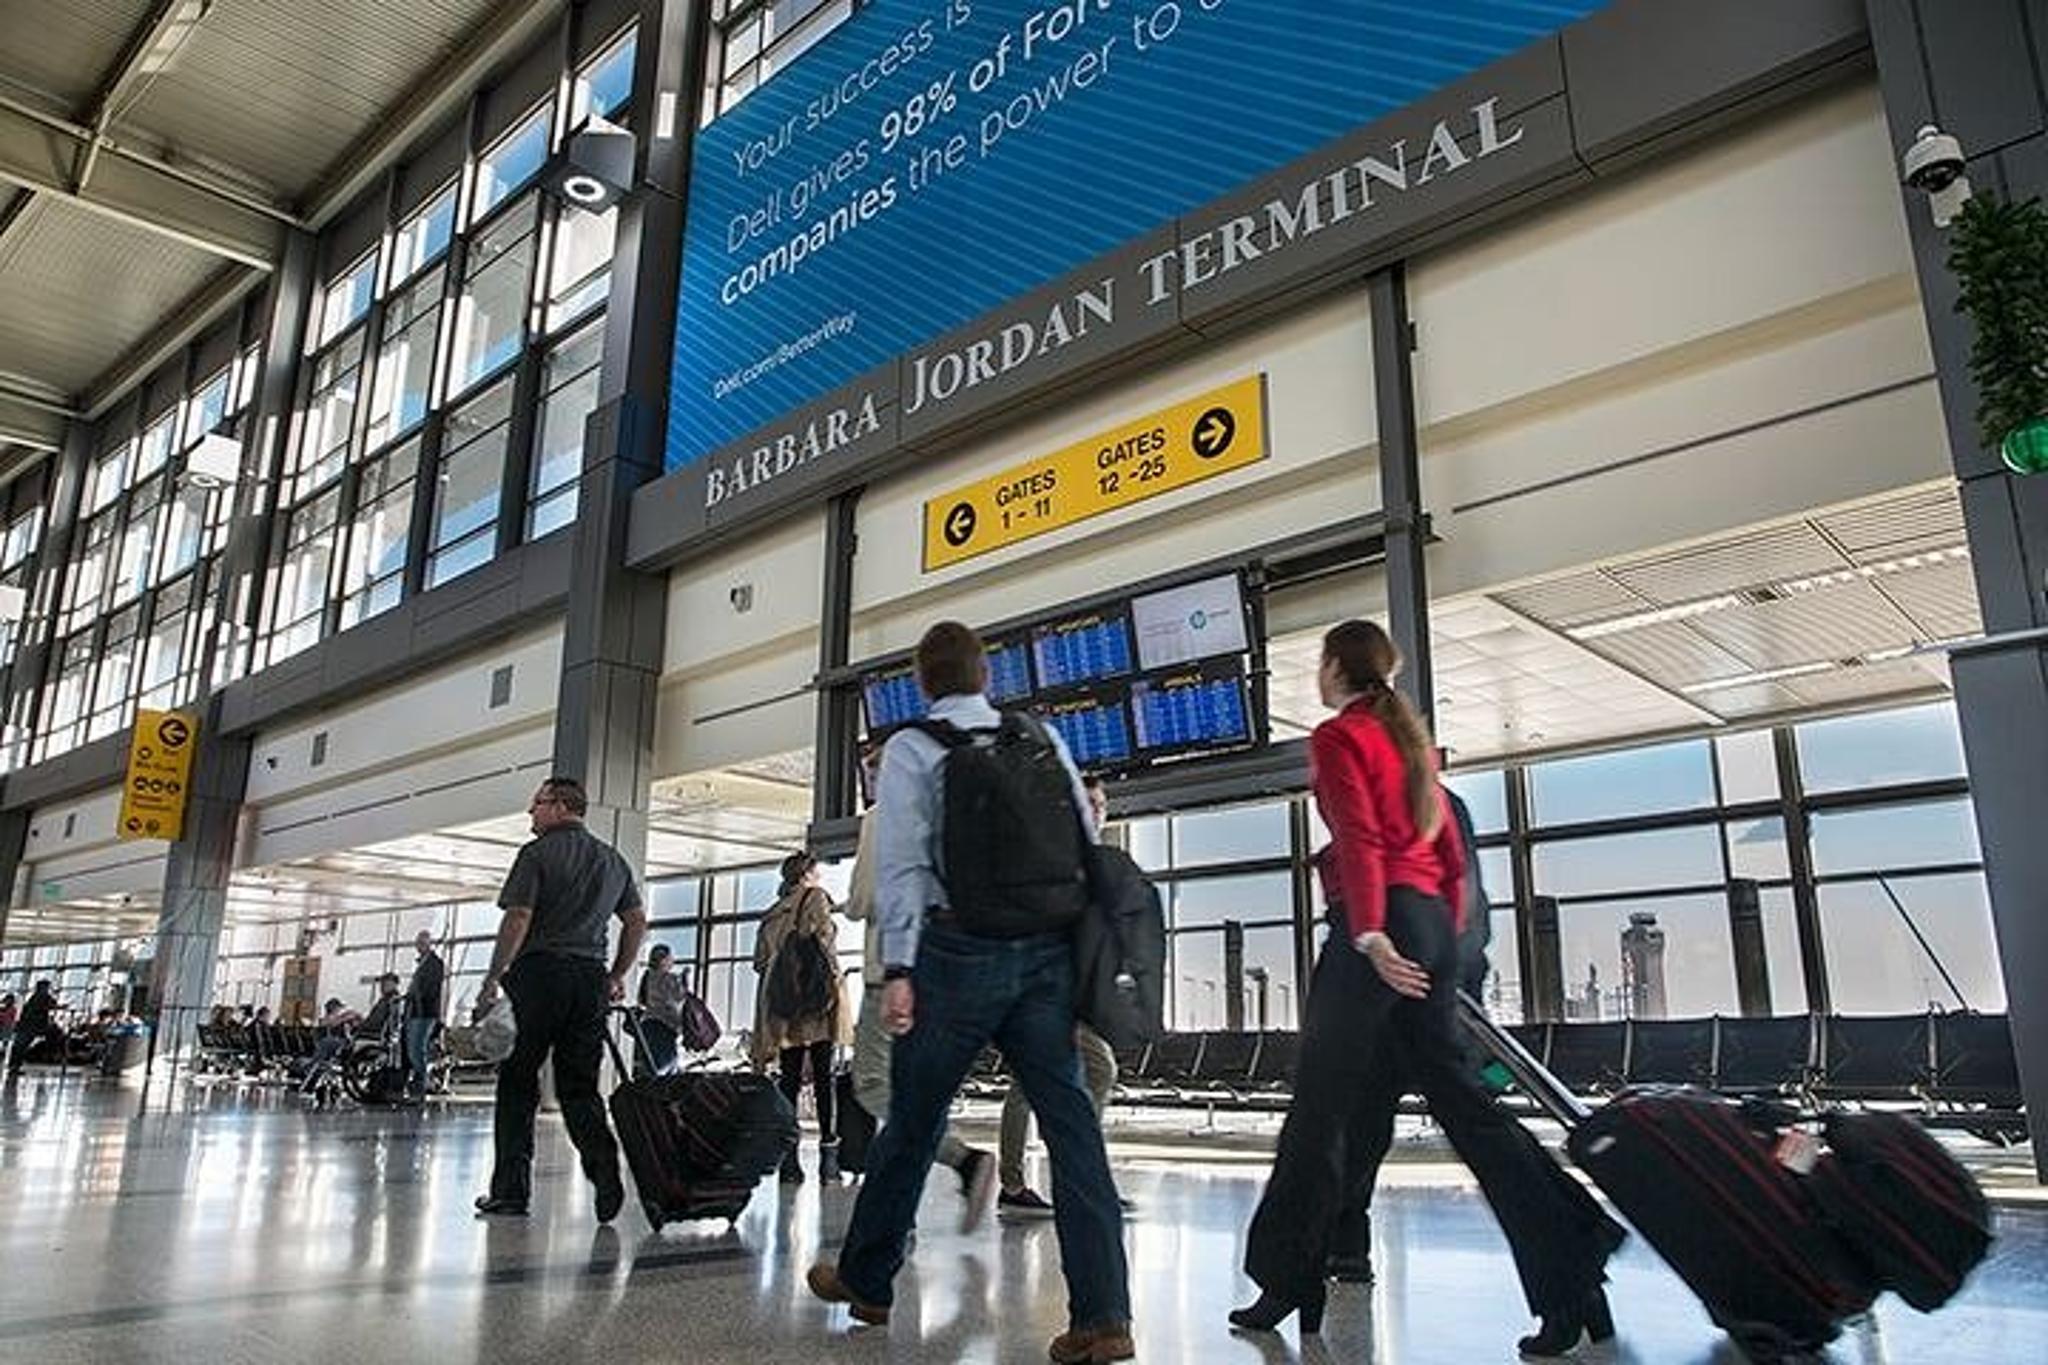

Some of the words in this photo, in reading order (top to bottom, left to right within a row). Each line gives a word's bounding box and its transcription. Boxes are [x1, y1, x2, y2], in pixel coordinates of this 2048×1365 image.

[727, 187, 783, 255] Dell
[789, 138, 870, 220] gives
[880, 69, 957, 154] 98%
[968, 32, 1012, 94] of
[1023, 0, 1112, 60] For
[733, 114, 799, 178] Your
[805, 18, 935, 132] success
[945, 0, 972, 31] is
[720, 176, 897, 306] companies
[908, 133, 968, 191] the
[979, 35, 1118, 160] power
[1133, 2, 1182, 51] to
[703, 390, 882, 509] BARBARA
[905, 277, 1116, 414] JORDAN
[1138, 96, 1525, 306] TERMINAL
[995, 467, 1057, 508] GATES
[1096, 427, 1167, 470] GATES
[1097, 472, 1120, 496] 12
[1001, 510, 1011, 530] 1
[1033, 497, 1052, 519] 11
